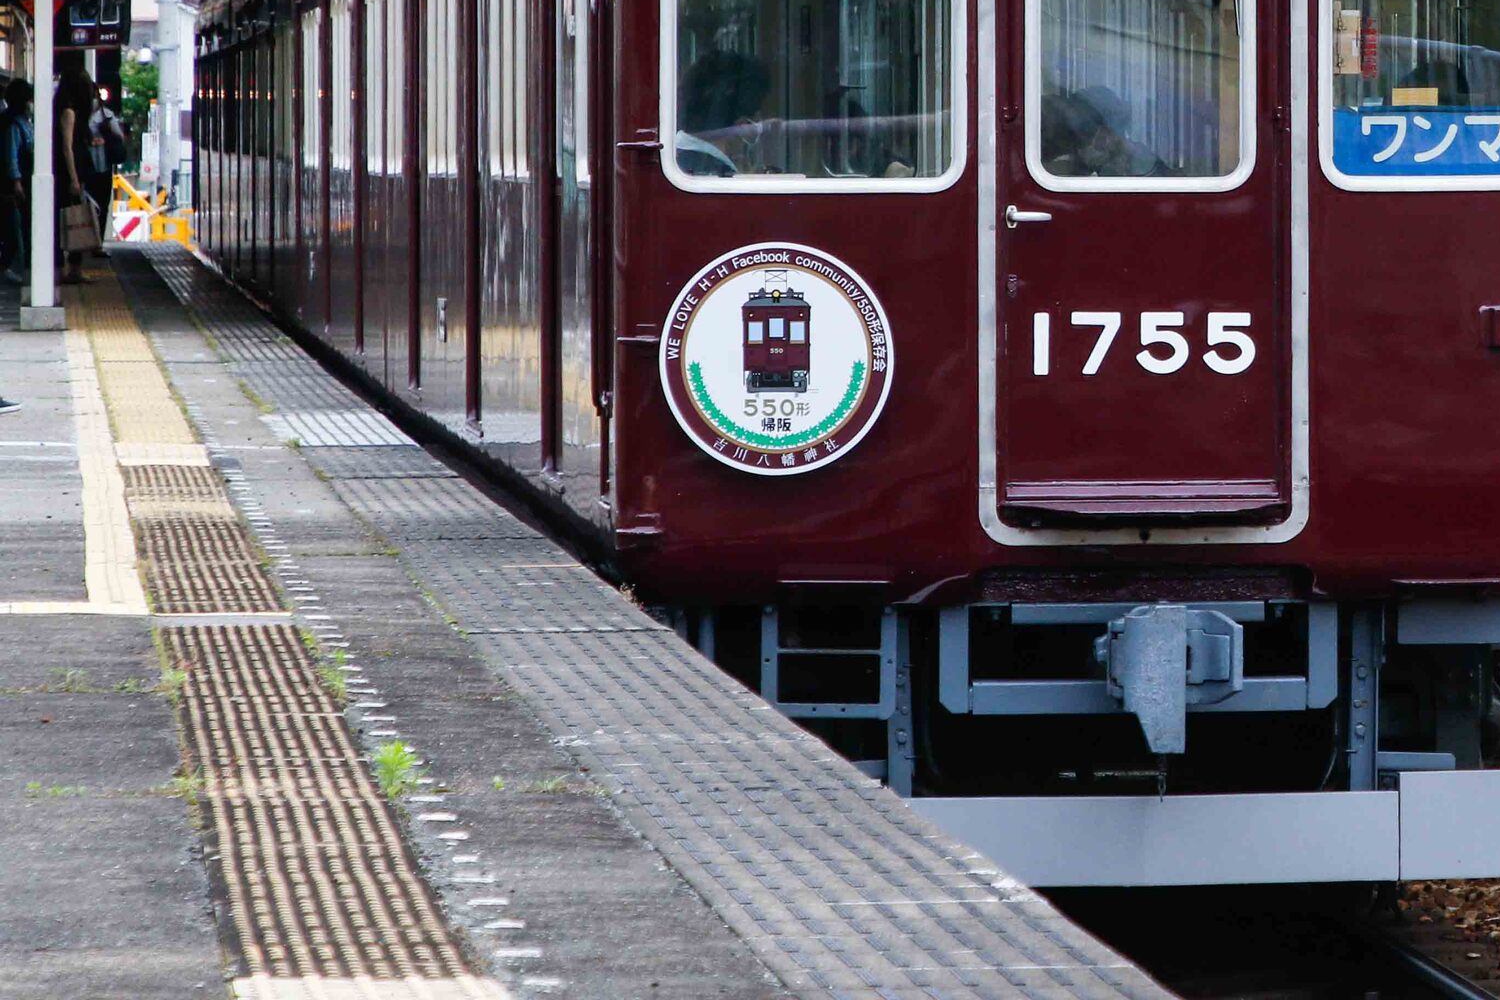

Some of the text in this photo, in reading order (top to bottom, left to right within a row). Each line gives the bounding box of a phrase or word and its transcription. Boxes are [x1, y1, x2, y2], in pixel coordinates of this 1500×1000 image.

[732, 251, 790, 270] Facebook
[673, 294, 698, 331] LOVE
[667, 337, 681, 360] WE
[1033, 311, 1257, 376] 1755
[742, 399, 811, 417] 550形
[760, 417, 792, 433] 帰阪
[712, 438, 840, 466] 吉川八幡神社
